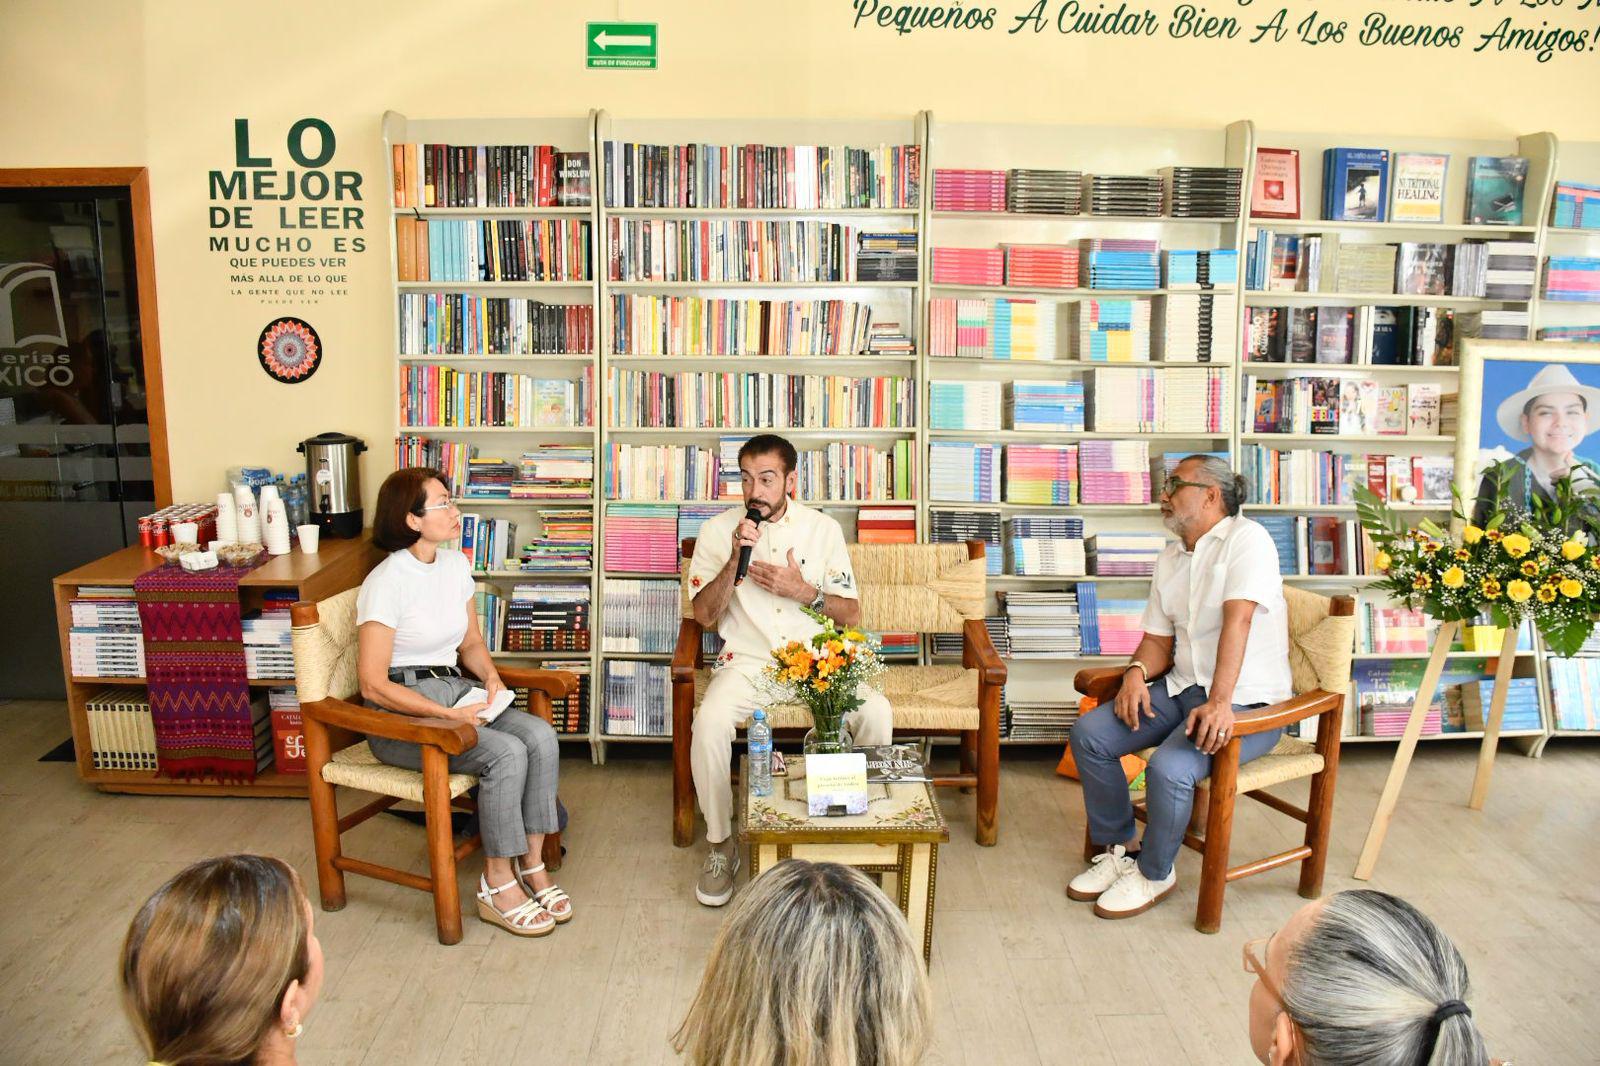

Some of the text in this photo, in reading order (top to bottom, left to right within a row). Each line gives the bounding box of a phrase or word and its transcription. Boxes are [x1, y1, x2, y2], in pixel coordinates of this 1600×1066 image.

[853, 0, 1600, 63] Pequeños A Cuidar Bien A Los Buenos Amigos!
[234, 118, 337, 168] LO
[208, 170, 363, 201] MEJOR
[1397, 189, 1439, 200] HEALING
[209, 206, 365, 229] DE LEER
[209, 236, 366, 253] MUCHO ES
[229, 257, 347, 268] QUE PUEDES VER
[289, 275, 303, 283] DE
[307, 275, 321, 283] LO
[325, 275, 348, 284] QUE
[0, 350, 71, 364] erías
